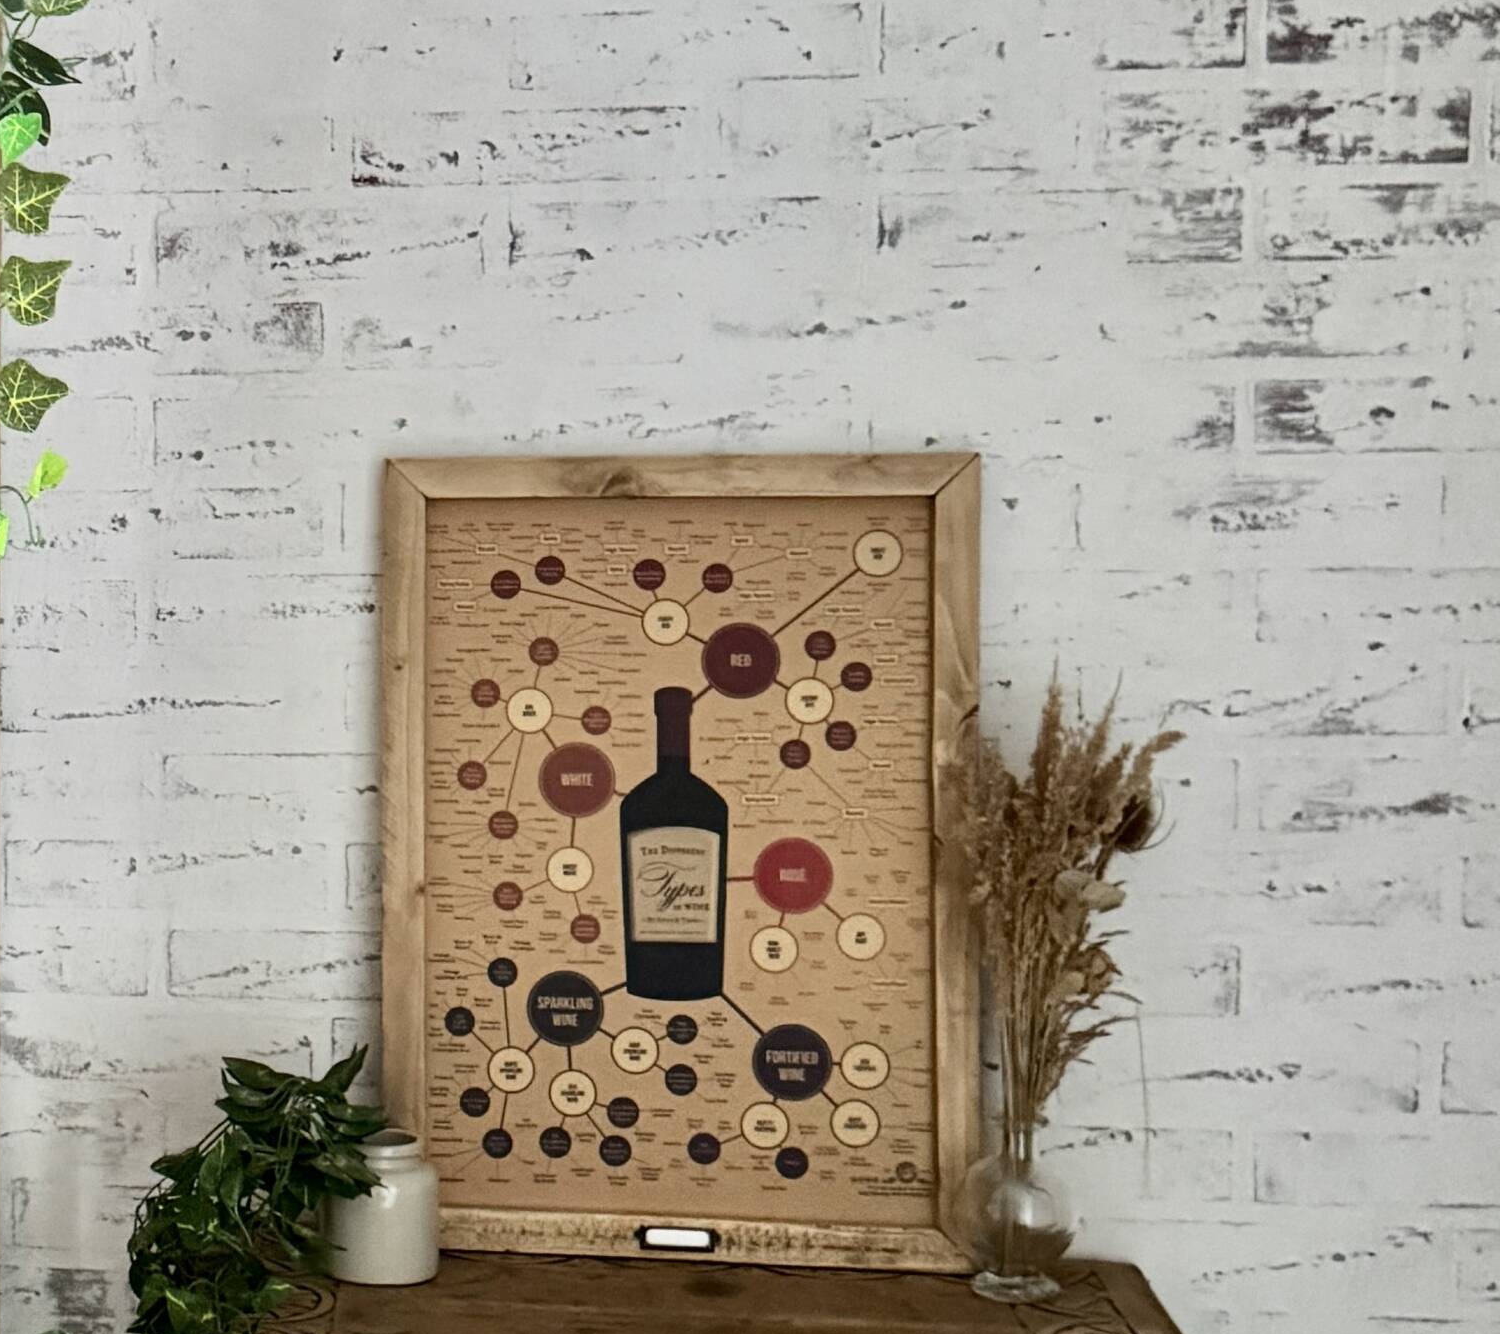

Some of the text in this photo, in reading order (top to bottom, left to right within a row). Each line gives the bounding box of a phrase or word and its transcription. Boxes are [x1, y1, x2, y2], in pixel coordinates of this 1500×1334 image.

[560, 772, 594, 787] WHITE
[636, 861, 705, 912] Types
[537, 996, 594, 1010] SPARKLING
[552, 1012, 579, 1027] WINE
[765, 1049, 819, 1065] FORTIFIED
